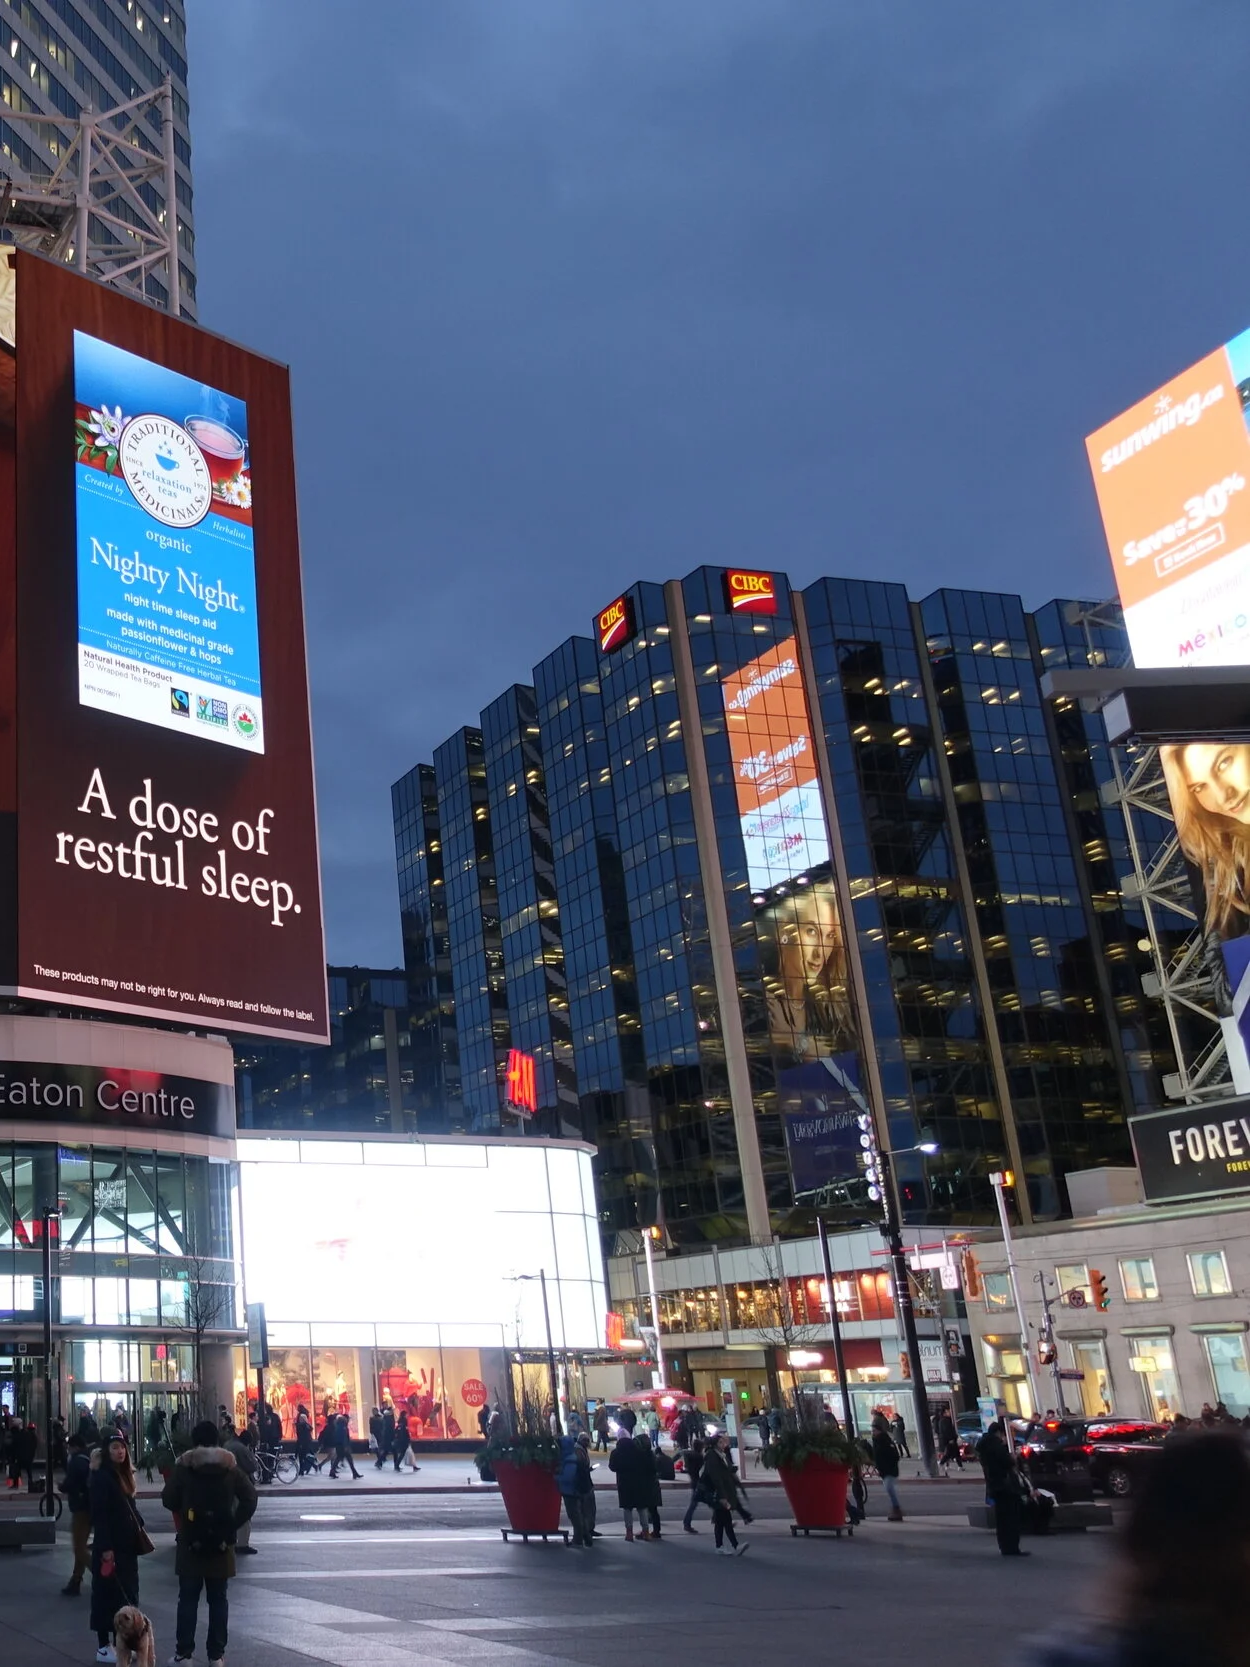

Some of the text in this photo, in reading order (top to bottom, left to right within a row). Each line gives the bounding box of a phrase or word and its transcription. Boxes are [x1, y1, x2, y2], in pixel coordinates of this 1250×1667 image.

[127, 423, 203, 477] TRADITIONAL
[84, 473, 124, 496] Created by
[142, 470, 192, 494] relaxation
[158, 485, 177, 498] teas
[1184, 472, 1246, 530] 30%
[146, 530, 192, 554] organic
[213, 521, 246, 540] Herbalists
[90, 537, 170, 594] Nighty
[731, 574, 771, 592] CIBC
[124, 593, 216, 630] night time sleep aid
[600, 601, 623, 630] CIBC
[107, 608, 234, 655] made with medicinal grade
[121, 626, 222, 665] passionflower & hops
[83, 650, 173, 683] Natural Health Product
[84, 660, 161, 689] 20 Wrapped Tea Bags
[106, 640, 236, 687] Naturally Caffeine Free Herbal Tea
[77, 768, 275, 856] A dose of
[55, 831, 302, 927] restful sleep.
[34, 964, 315, 1021] These products may not be right for you. Always read and follow the label.
[97, 1080, 196, 1119] Centre
[507, 1049, 536, 1112] H&M
[464, 1383, 483, 1391] SALE
